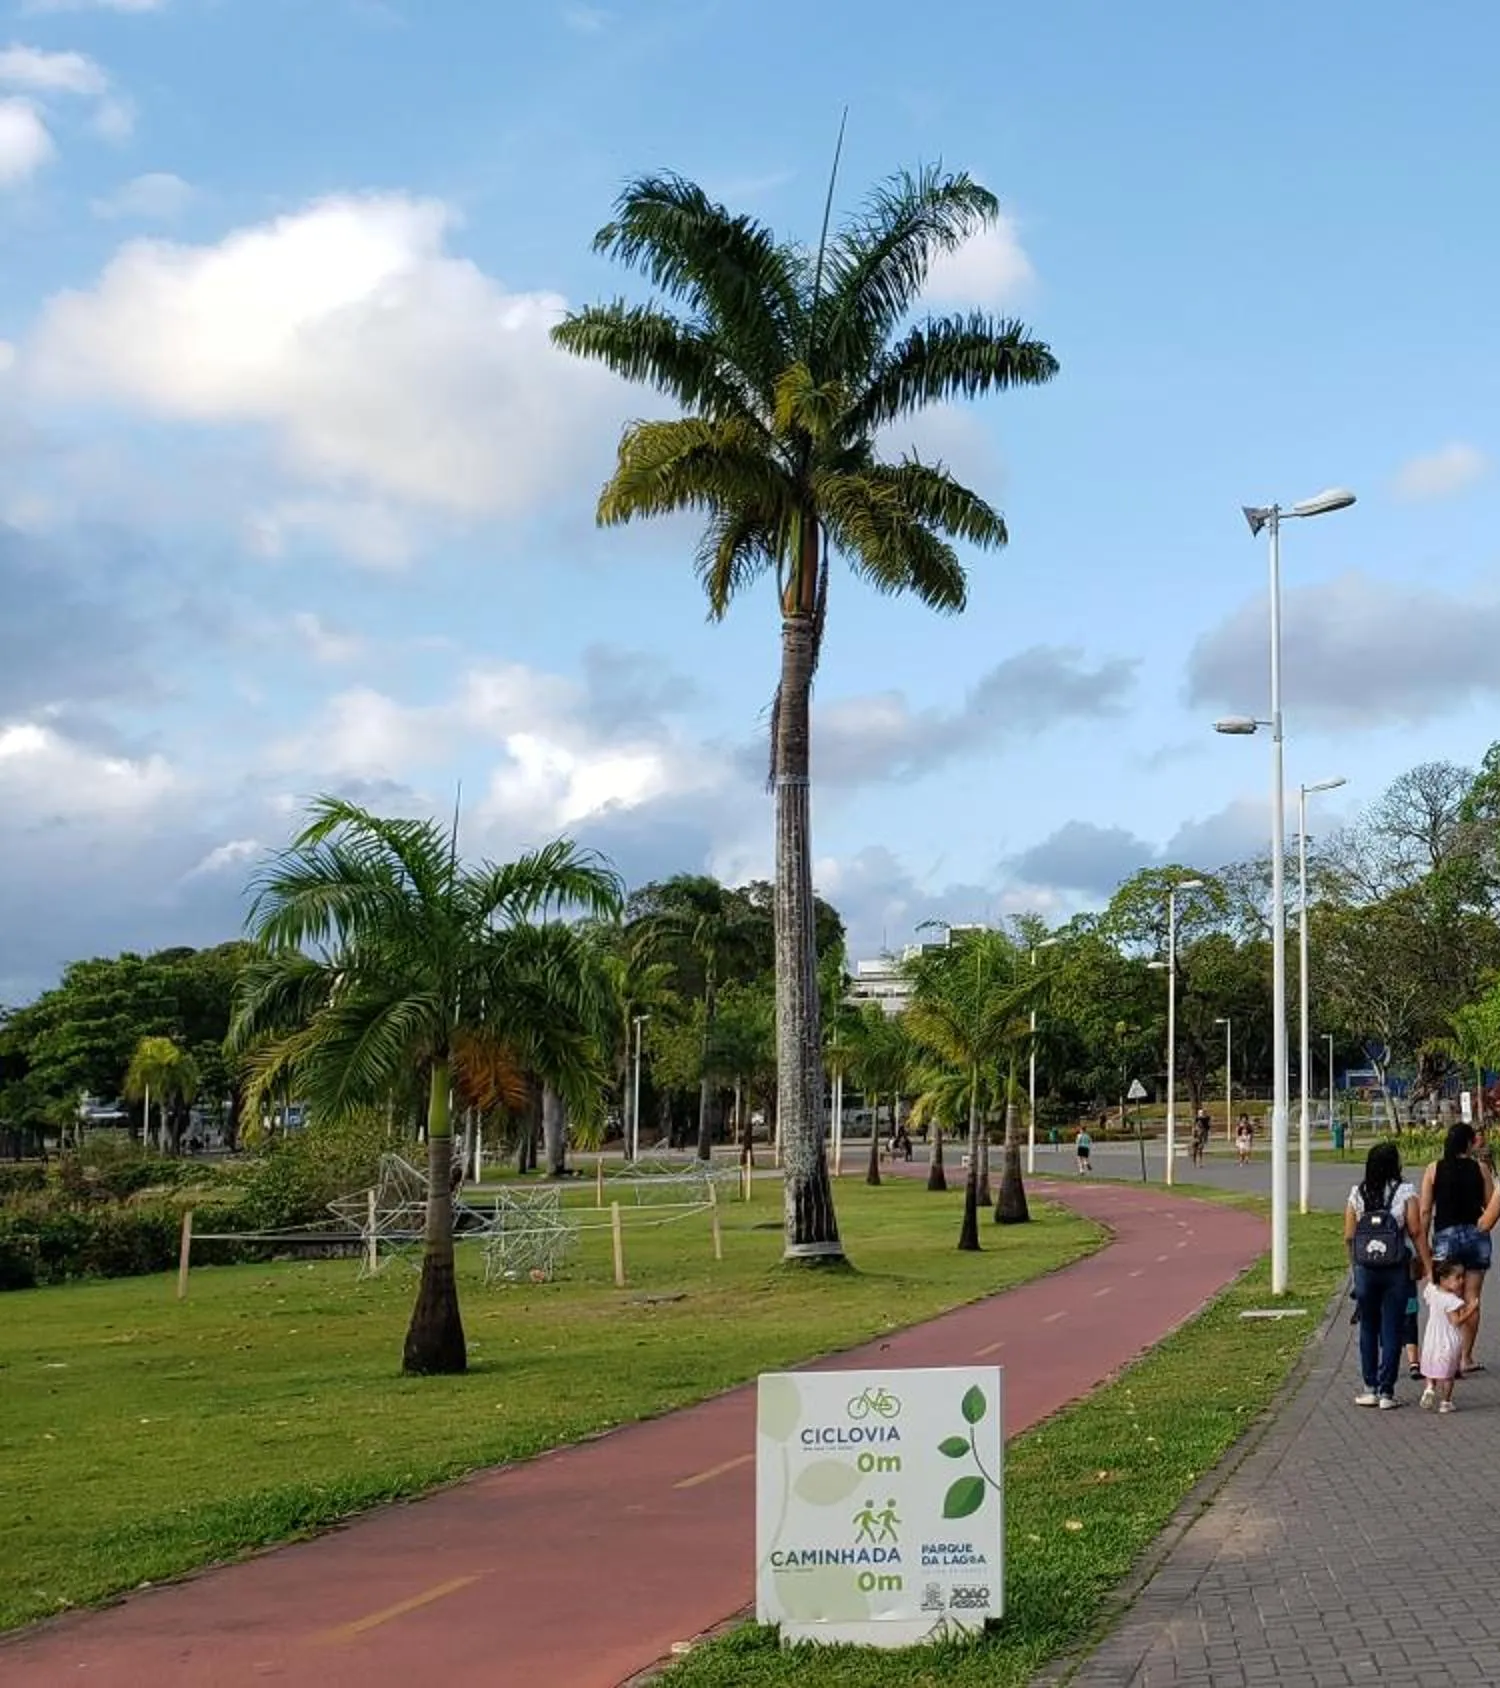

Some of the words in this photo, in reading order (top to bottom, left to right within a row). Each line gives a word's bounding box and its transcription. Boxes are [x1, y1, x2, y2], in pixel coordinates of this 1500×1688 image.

[801, 1426, 901, 1444] CICLOVIA
[921, 1543, 973, 1554] PARQUE
[770, 1547, 902, 1567] CAMINHADA
[921, 1555, 940, 1566] DA
